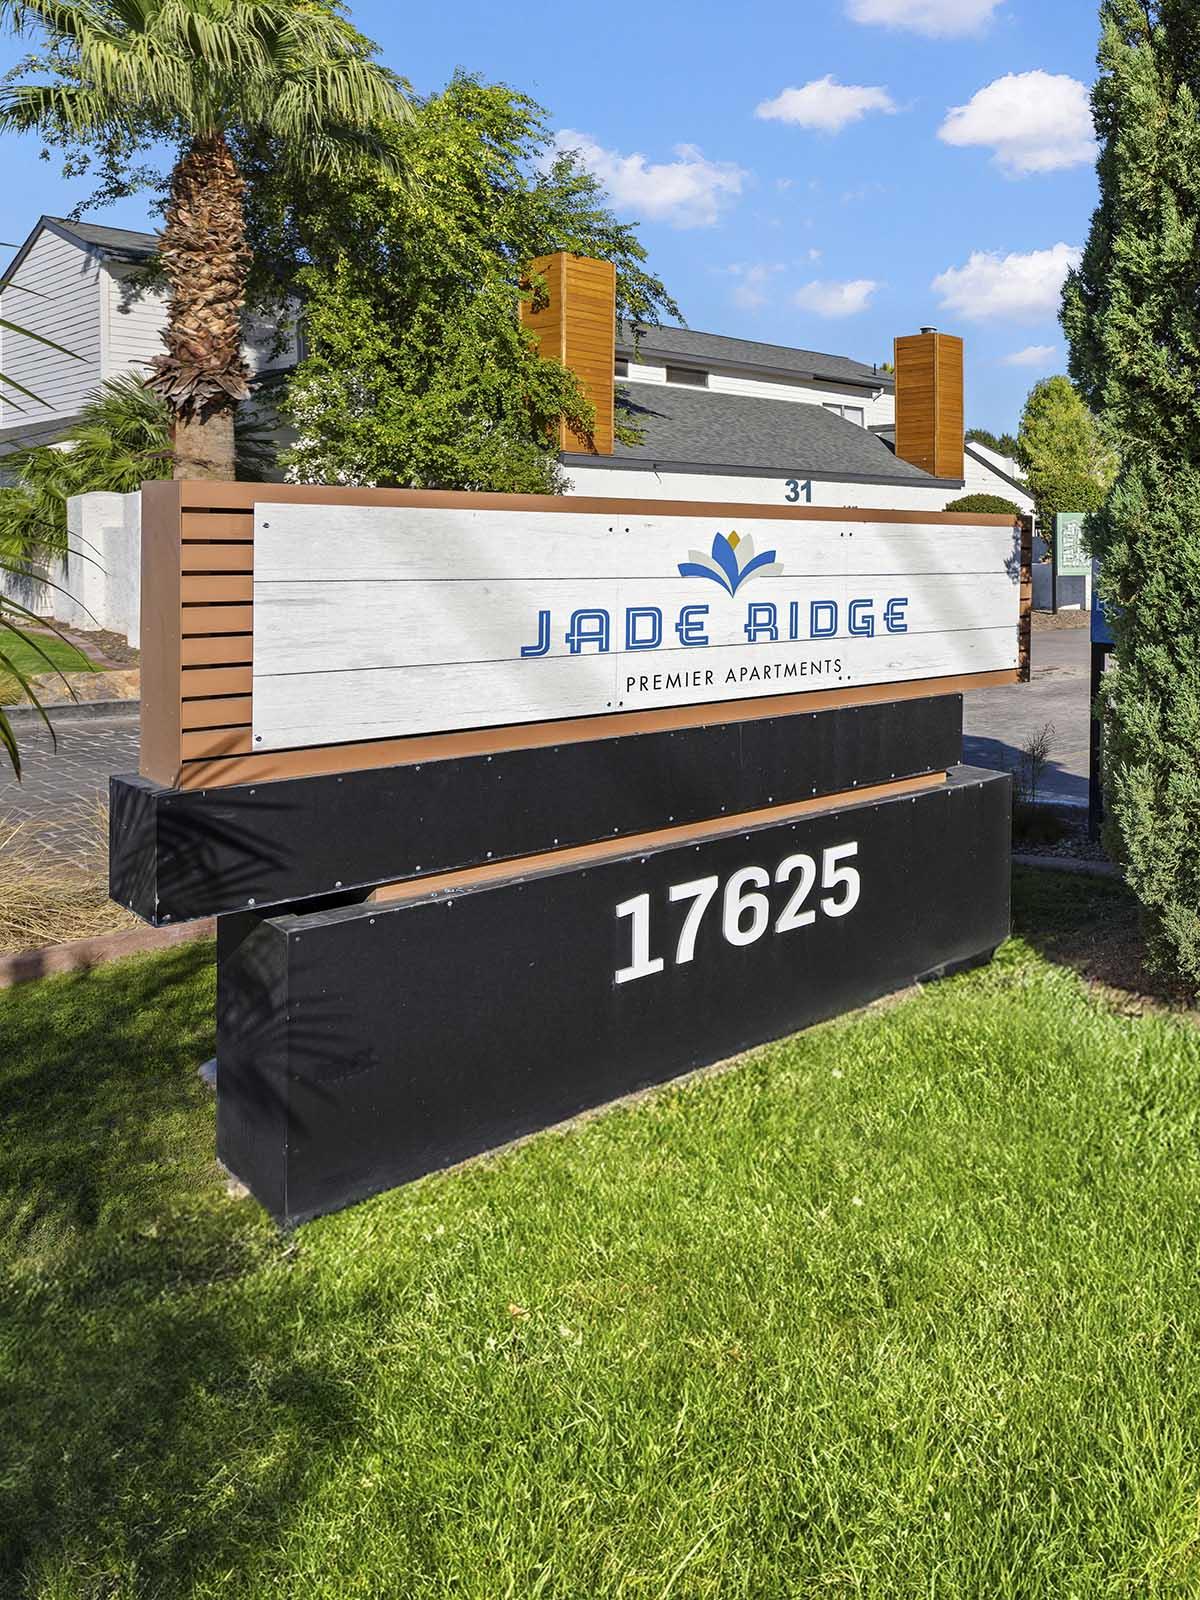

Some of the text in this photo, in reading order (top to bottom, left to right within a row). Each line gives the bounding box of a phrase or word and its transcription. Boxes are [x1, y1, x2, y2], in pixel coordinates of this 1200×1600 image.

[784, 479, 812, 503] 31
[519, 597, 909, 657] JADE RIDGE
[625, 658, 843, 693] PREMIER APARTMENTS
[614, 841, 861, 985] 17625
